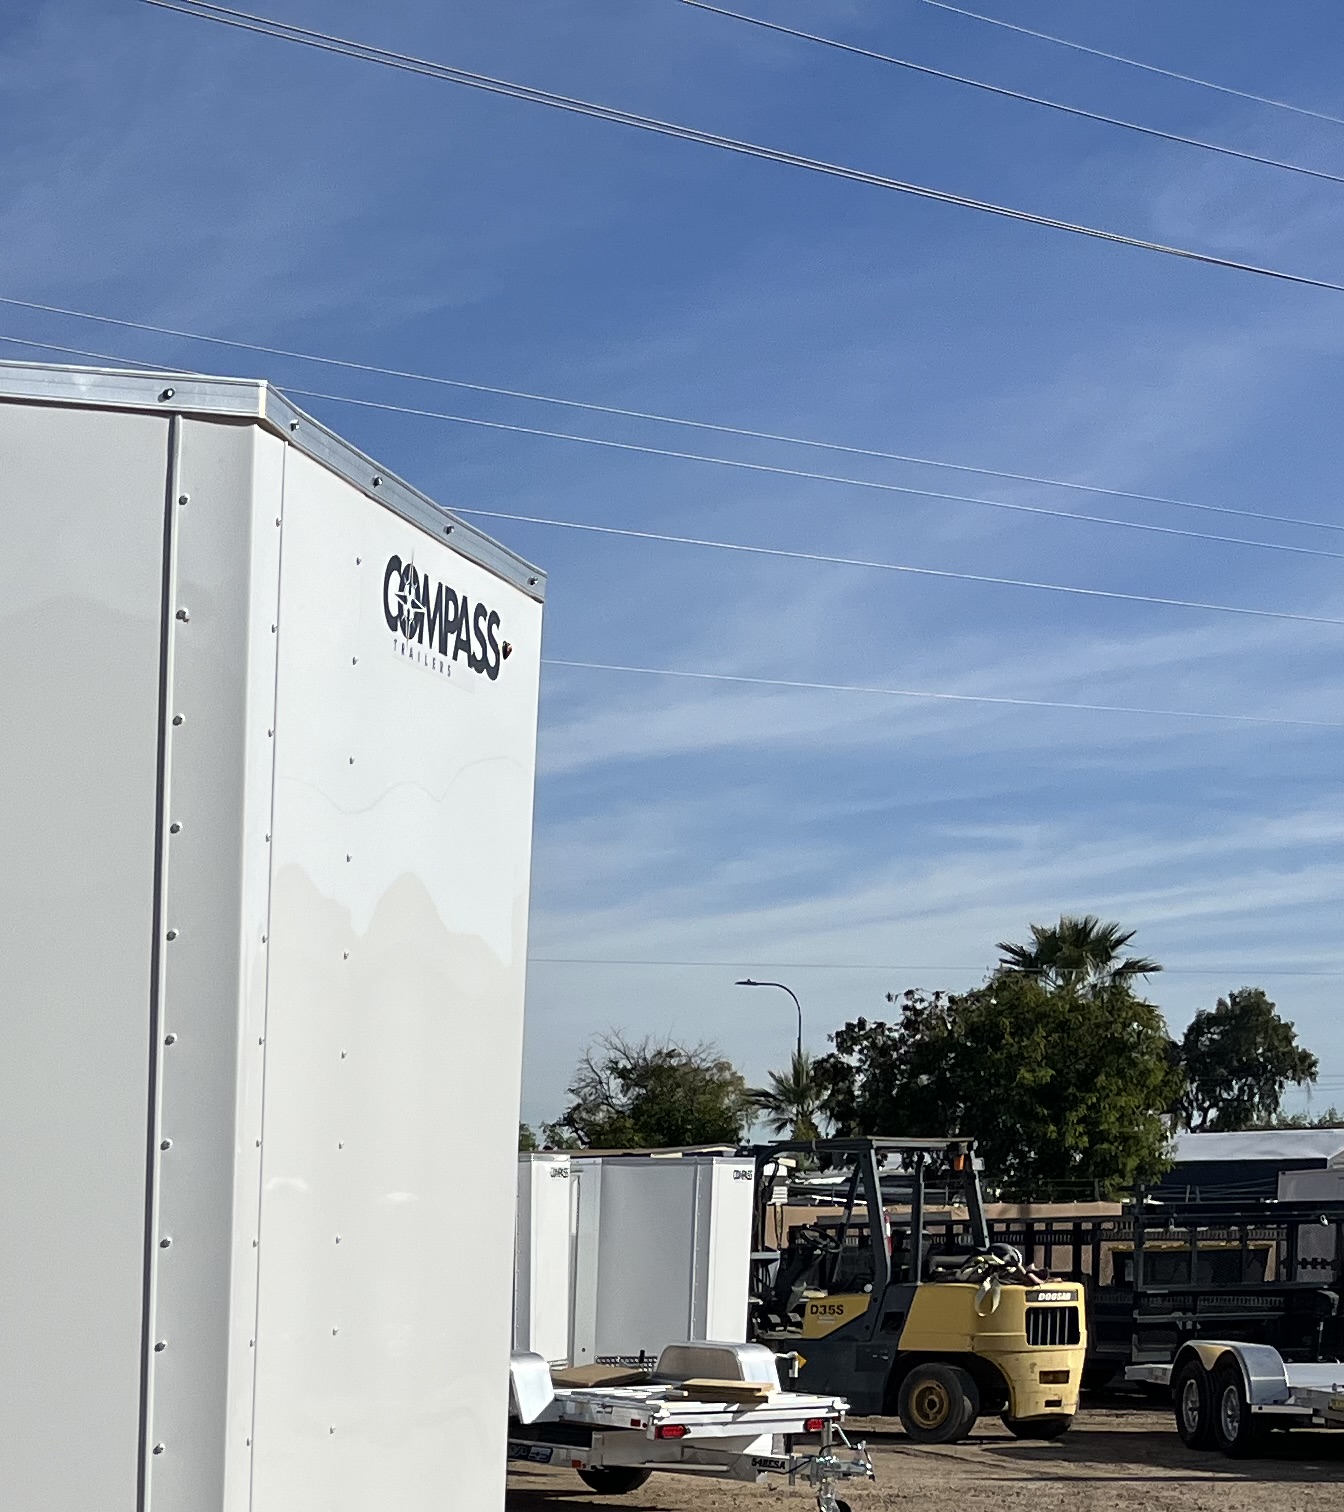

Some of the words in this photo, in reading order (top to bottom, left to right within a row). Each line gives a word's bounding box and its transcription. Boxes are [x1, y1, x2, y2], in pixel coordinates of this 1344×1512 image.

[383, 554, 501, 681] COMPASS
[394, 638, 451, 677] TRAILERS
[810, 1304, 844, 1316] D35S
